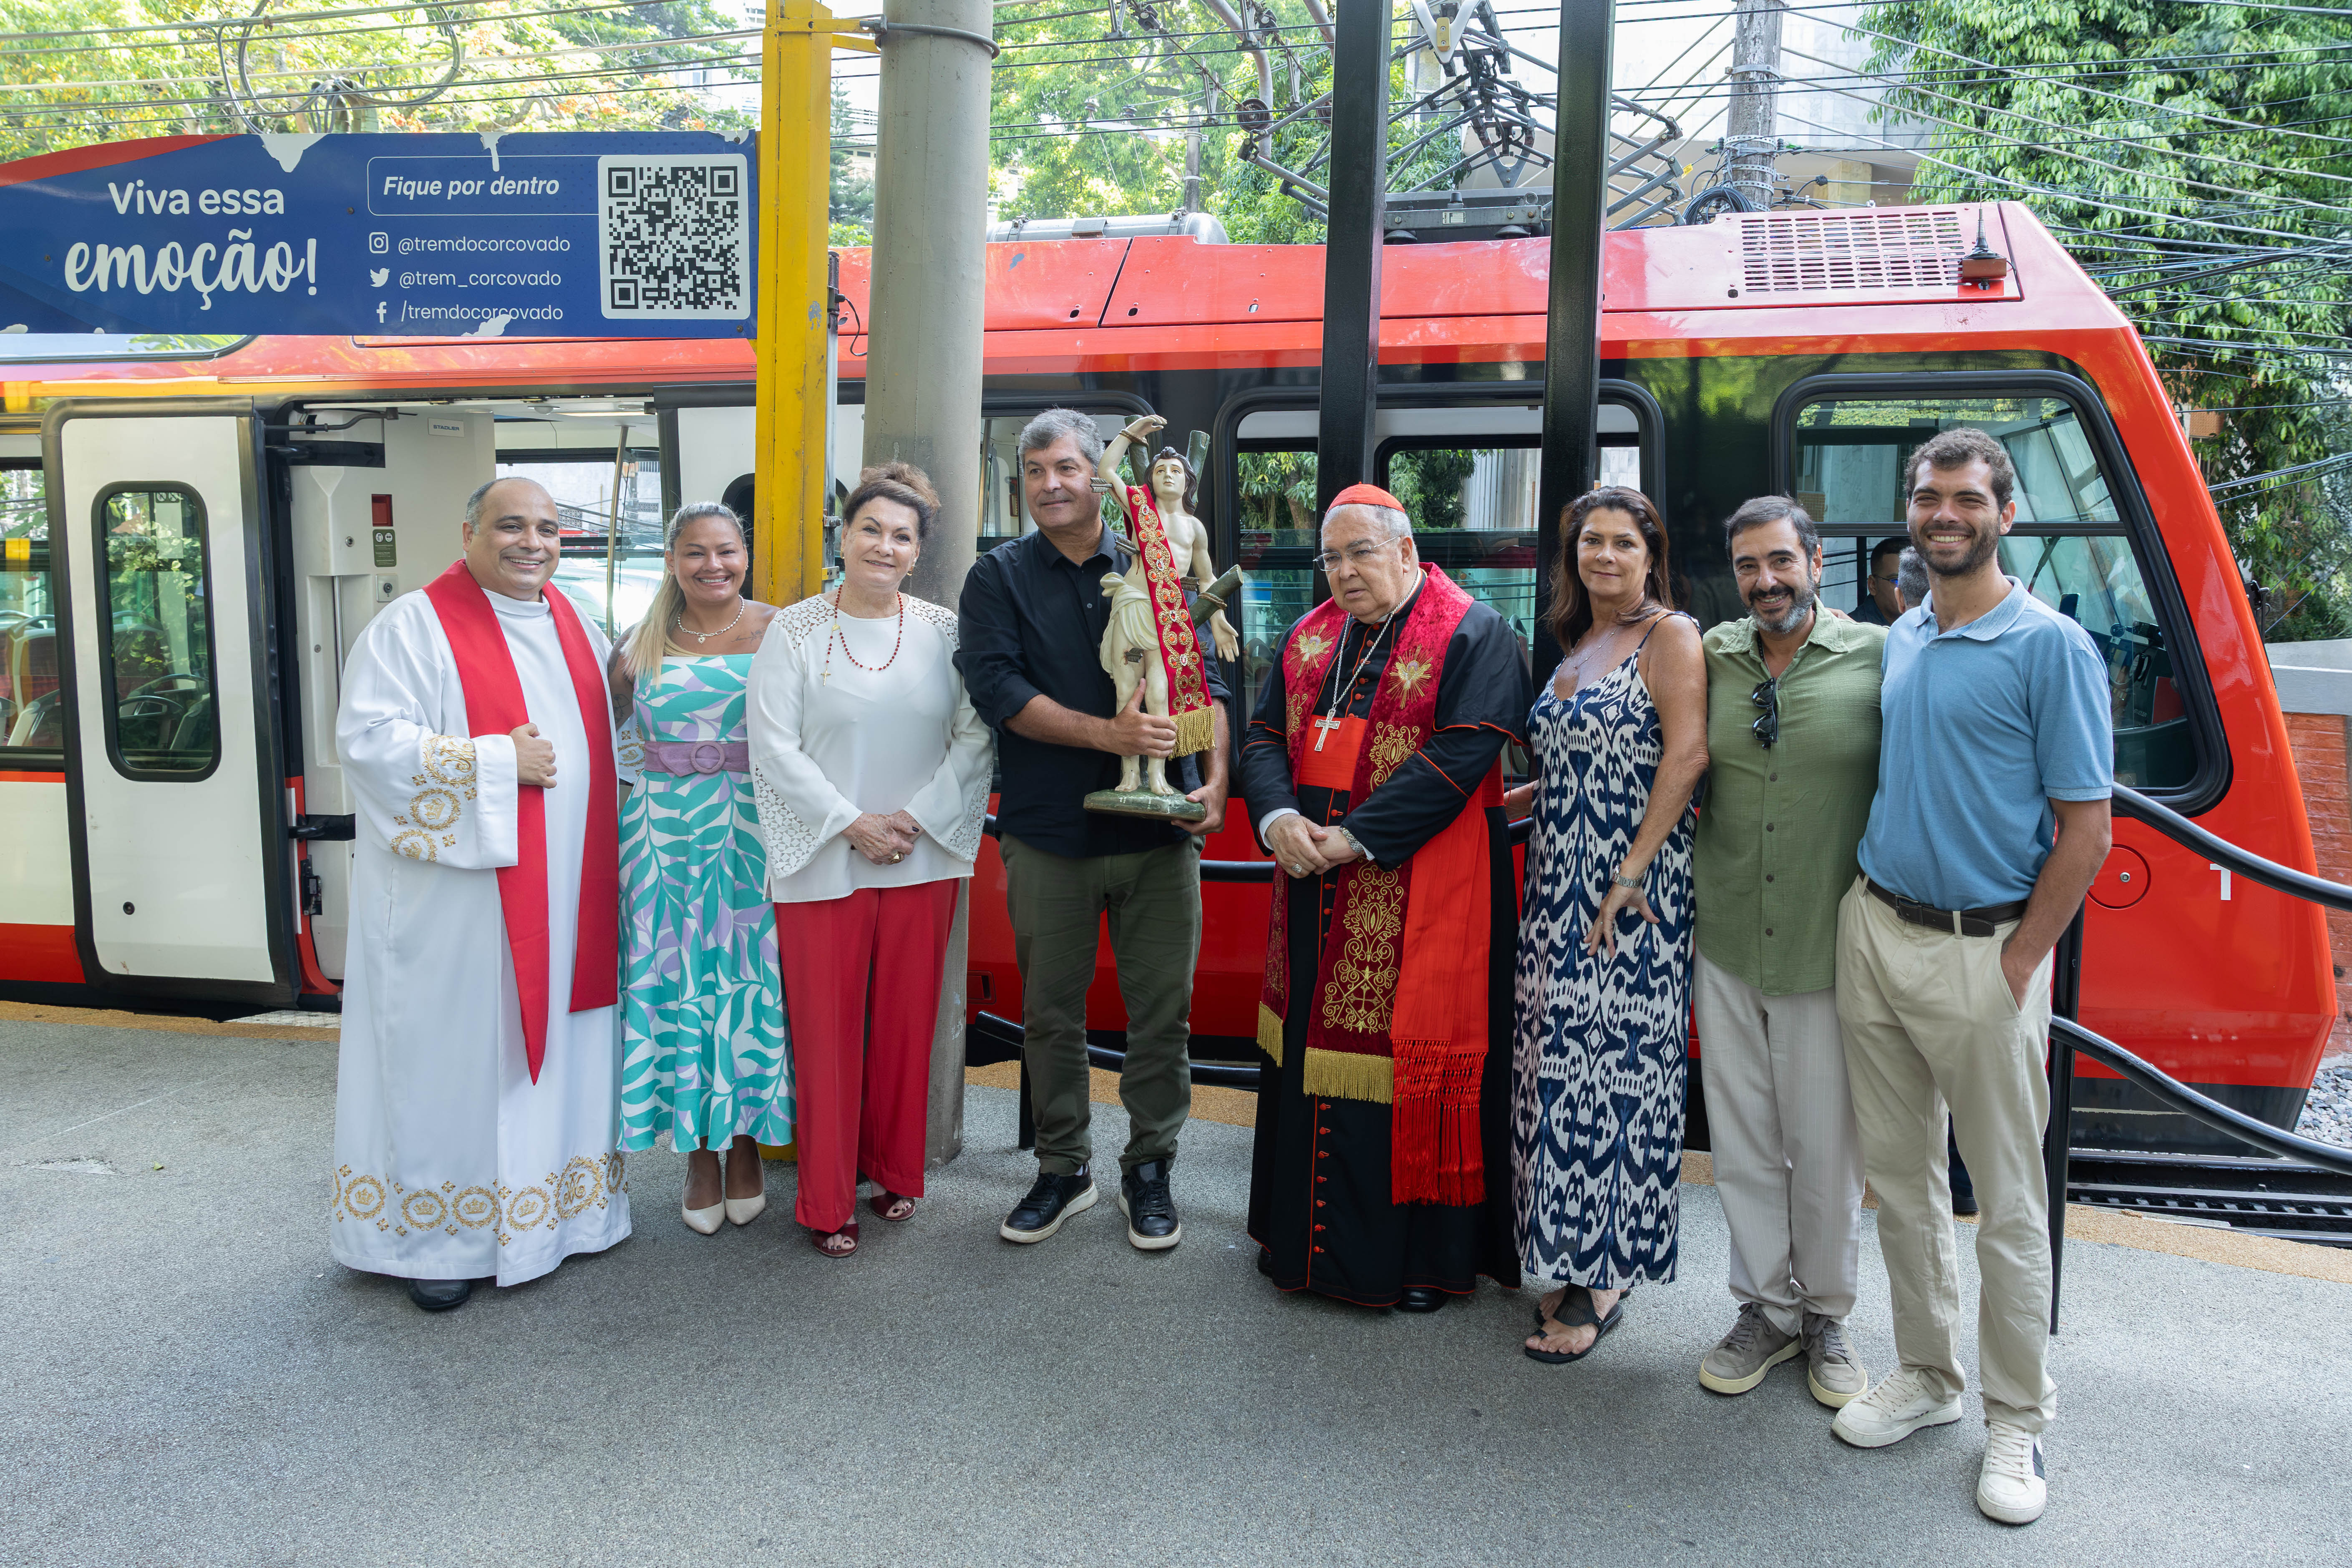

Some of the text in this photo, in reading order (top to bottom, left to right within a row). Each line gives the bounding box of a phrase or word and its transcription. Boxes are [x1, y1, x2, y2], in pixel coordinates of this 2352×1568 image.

[108, 180, 285, 215] Viva essa
[383, 176, 560, 200] Fique por dentro
[398, 236, 571, 255] @tremdocorcovado
[65, 228, 317, 311] emoção!
[399, 270, 562, 289] @trem_corcovado
